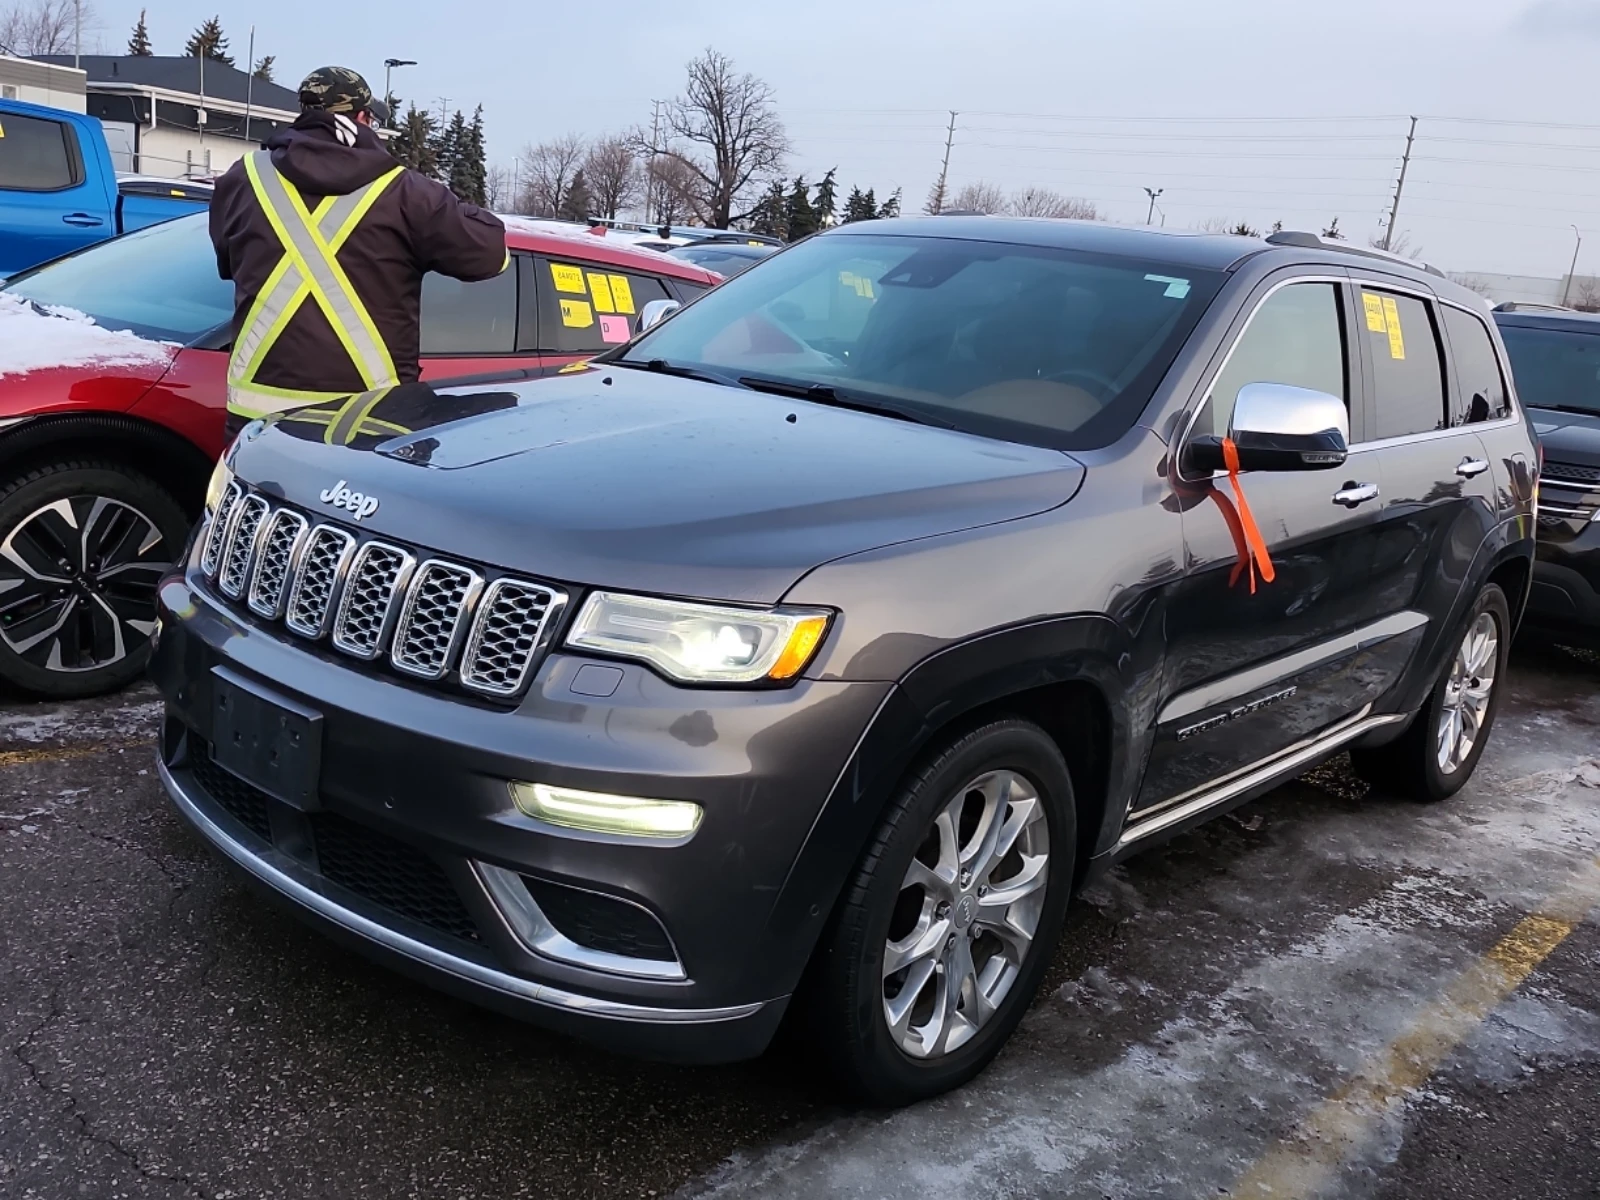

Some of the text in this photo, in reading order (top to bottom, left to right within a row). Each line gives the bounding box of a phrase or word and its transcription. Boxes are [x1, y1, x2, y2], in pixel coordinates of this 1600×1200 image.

[563, 306, 571, 318] M
[602, 322, 610, 333] D
[320, 479, 379, 521] Jeep
